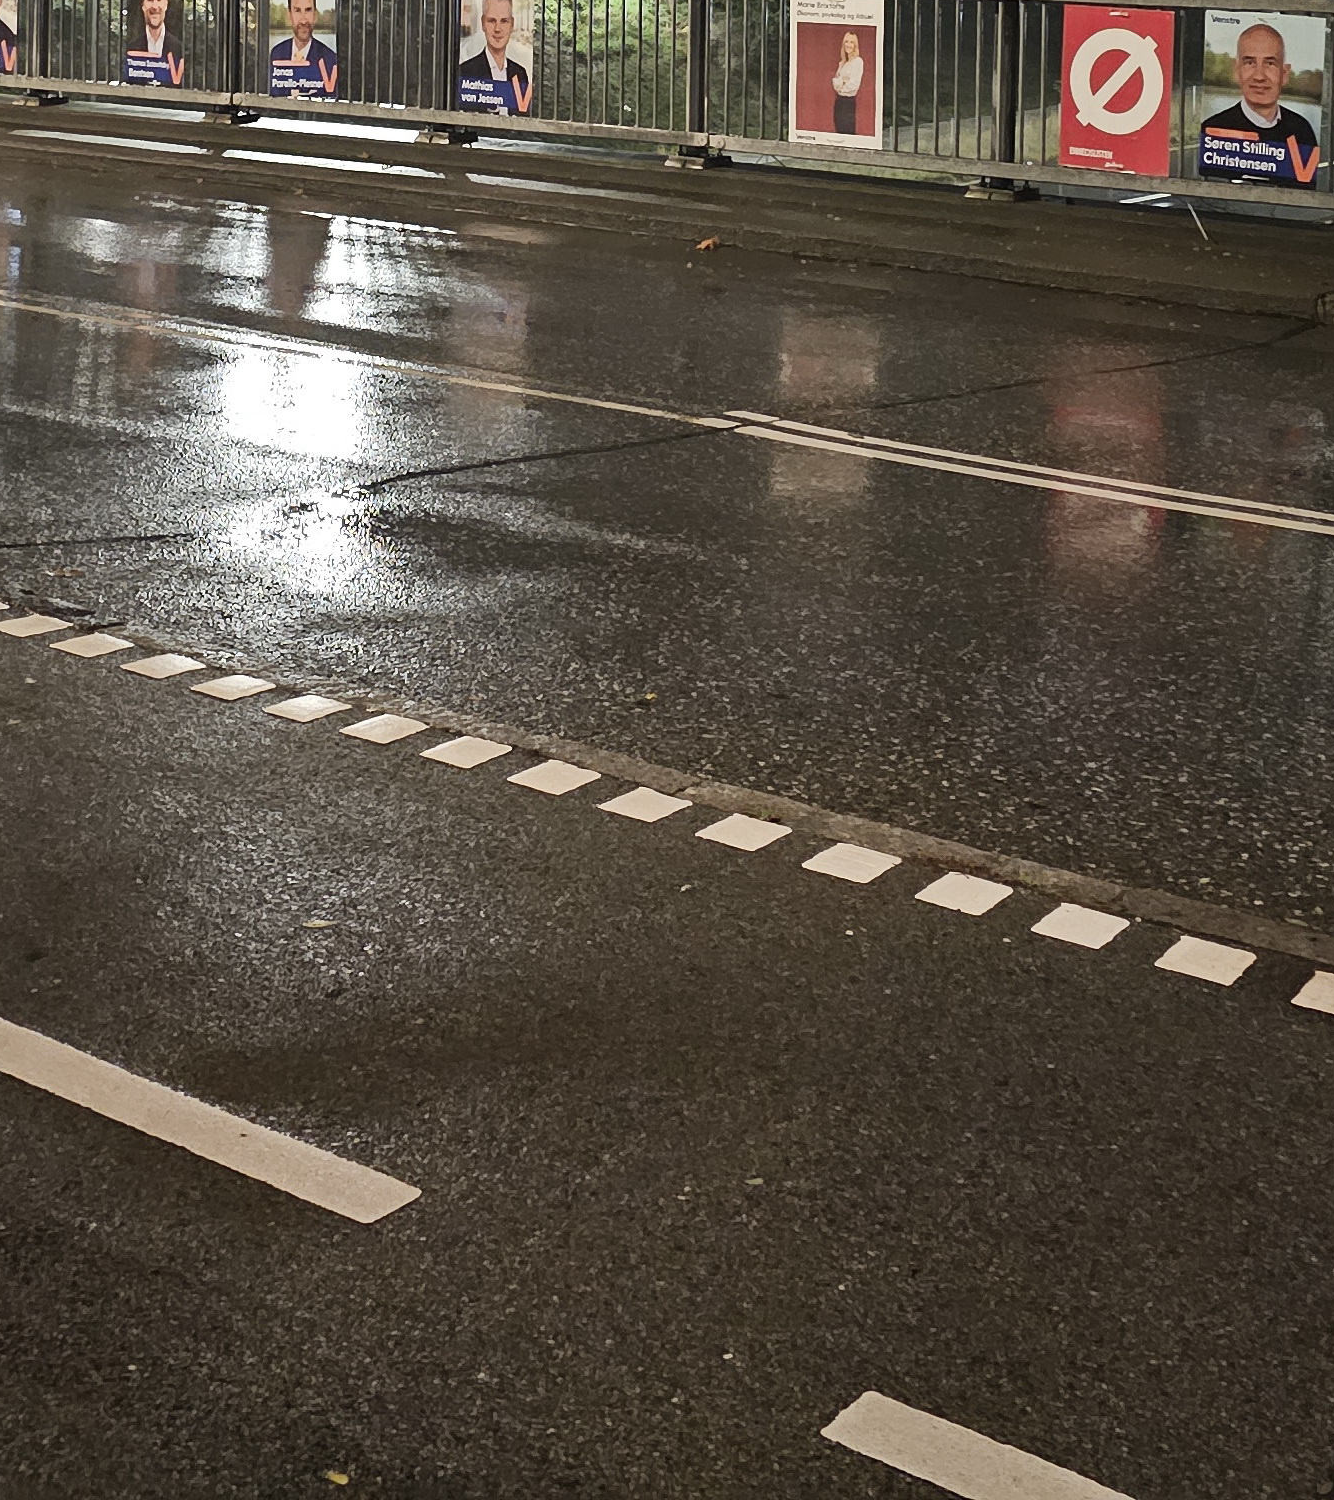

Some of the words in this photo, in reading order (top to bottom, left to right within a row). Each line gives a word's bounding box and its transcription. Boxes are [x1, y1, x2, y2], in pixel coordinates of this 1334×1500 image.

[1204, 136, 1240, 152] Søren
[1242, 141, 1285, 160] Stilling
[1203, 151, 1277, 172] Christensen
